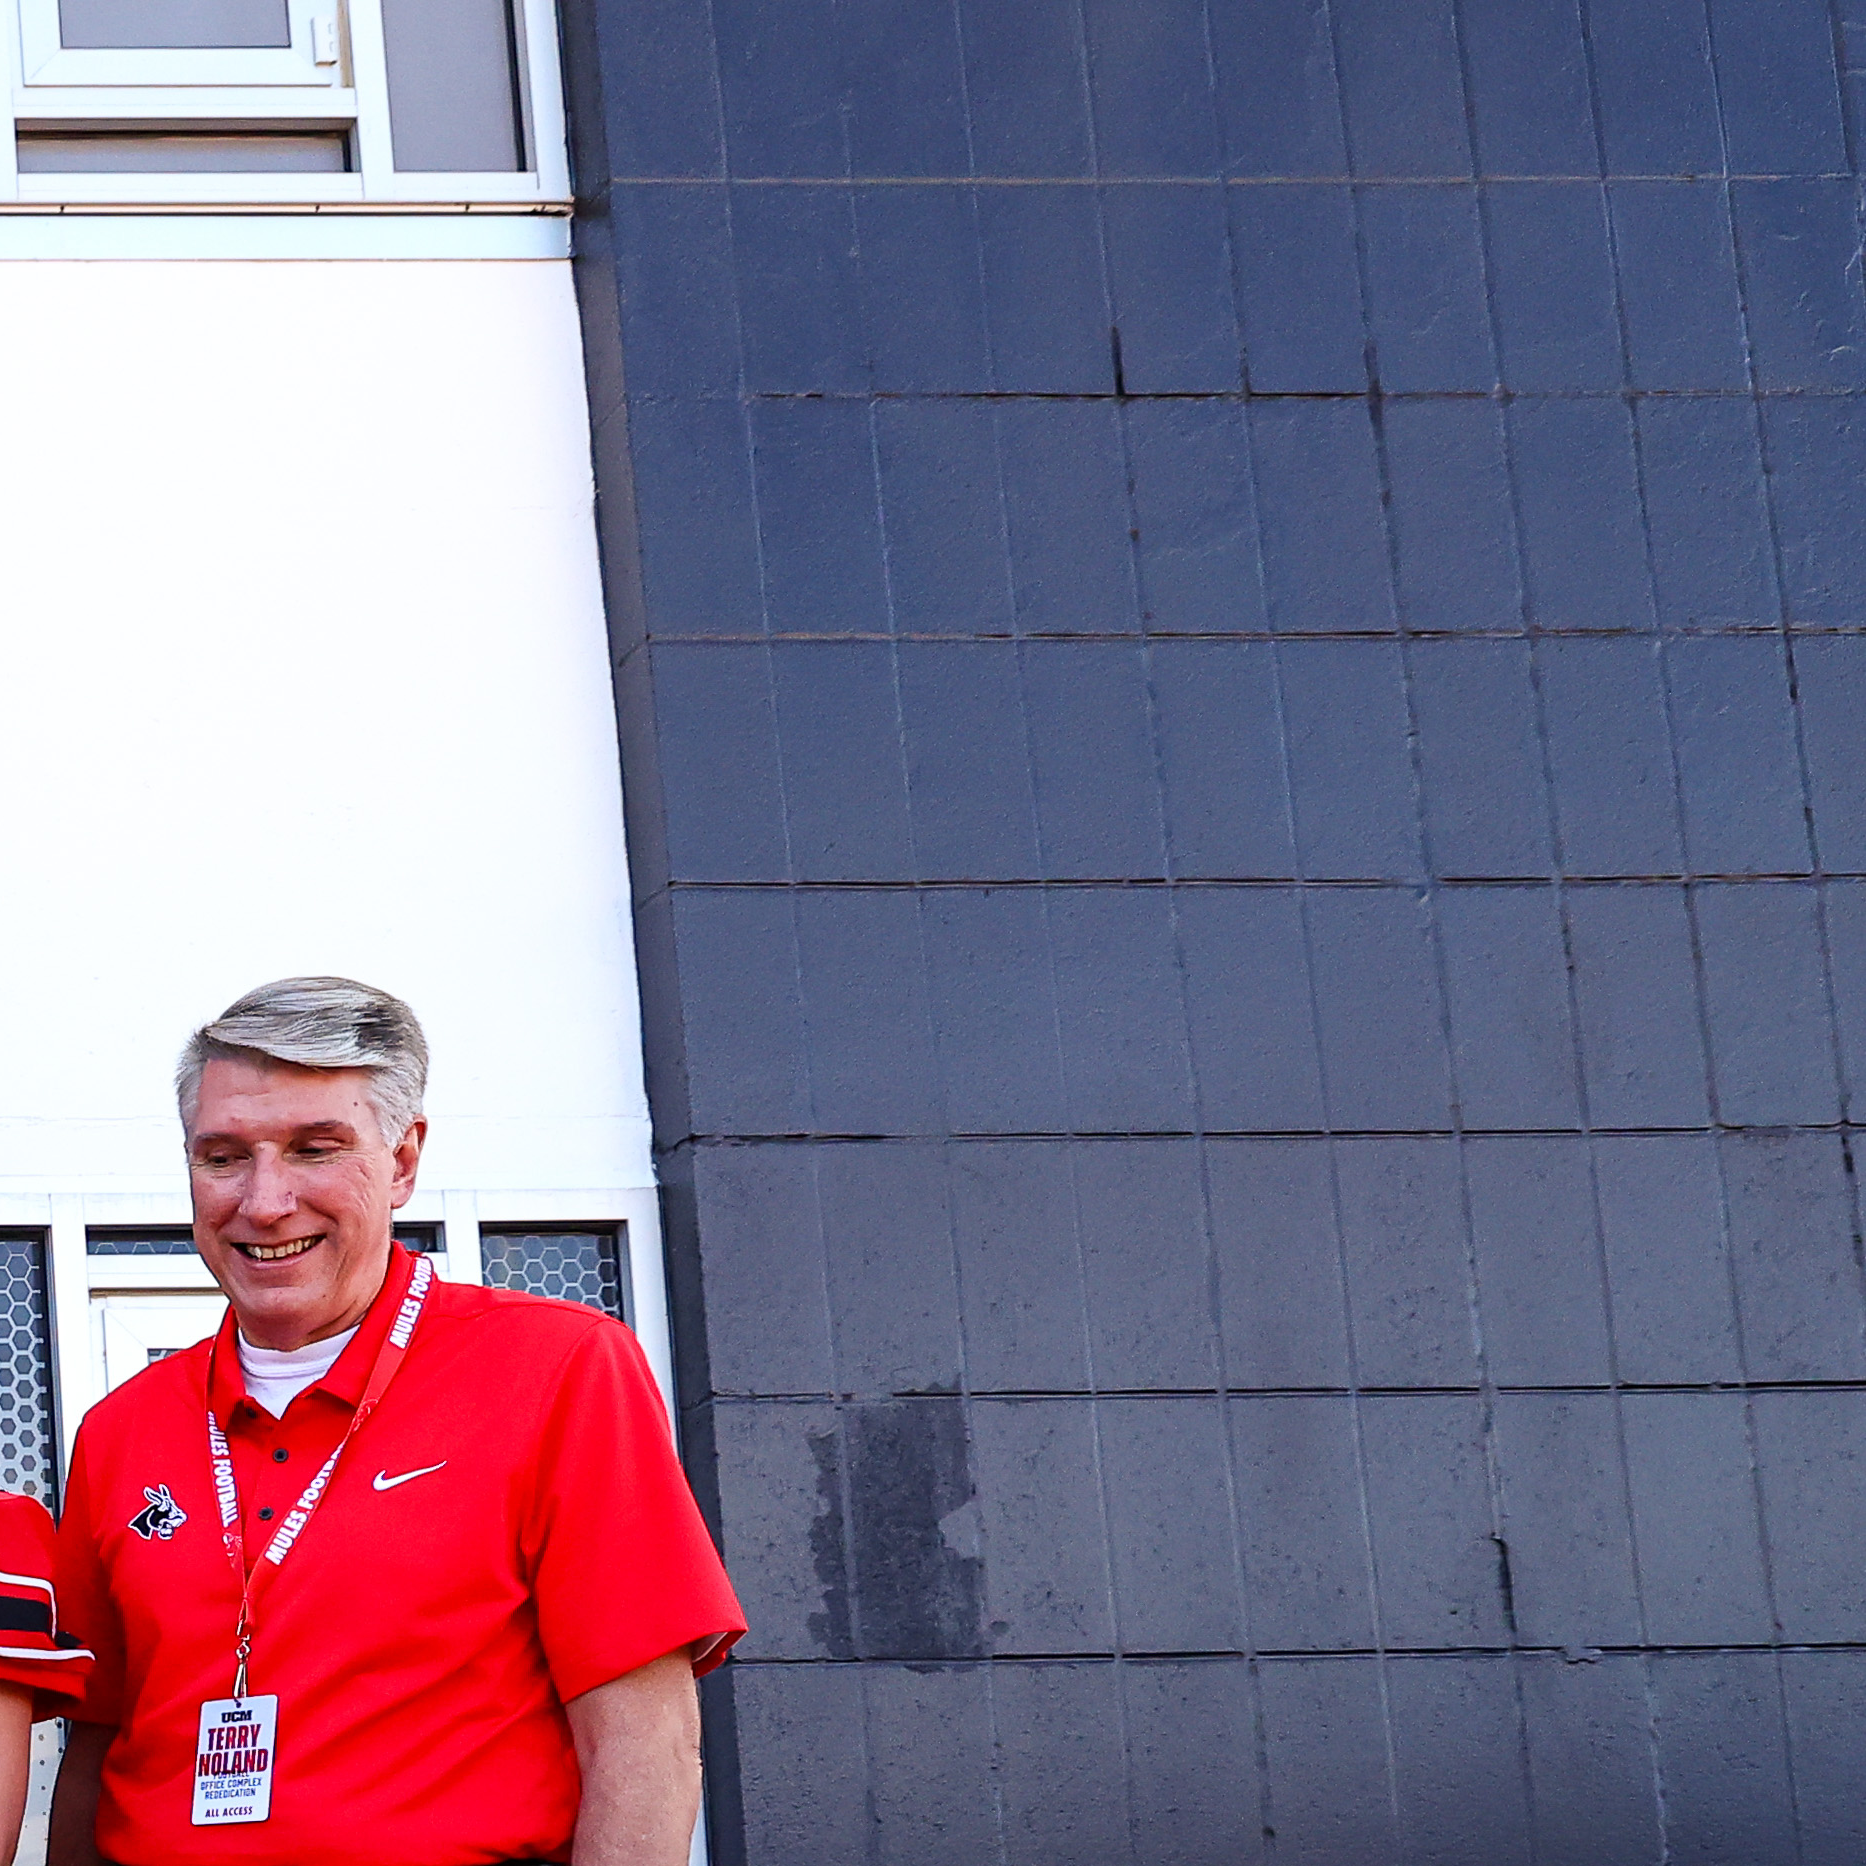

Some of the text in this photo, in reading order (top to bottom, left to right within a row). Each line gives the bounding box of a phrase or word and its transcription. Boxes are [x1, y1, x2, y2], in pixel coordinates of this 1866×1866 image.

[389, 1298, 422, 1349] MULES
[213, 1458, 239, 1528] FOOTBALL
[265, 1510, 308, 1565] MULES
[221, 1710, 252, 1723] UCM
[208, 1724, 262, 1751] TERRY
[198, 1748, 269, 1777] NOLAND
[201, 1777, 262, 1791] OFFICE COMPLEX
[205, 1806, 253, 1818] ALL ACCESS
